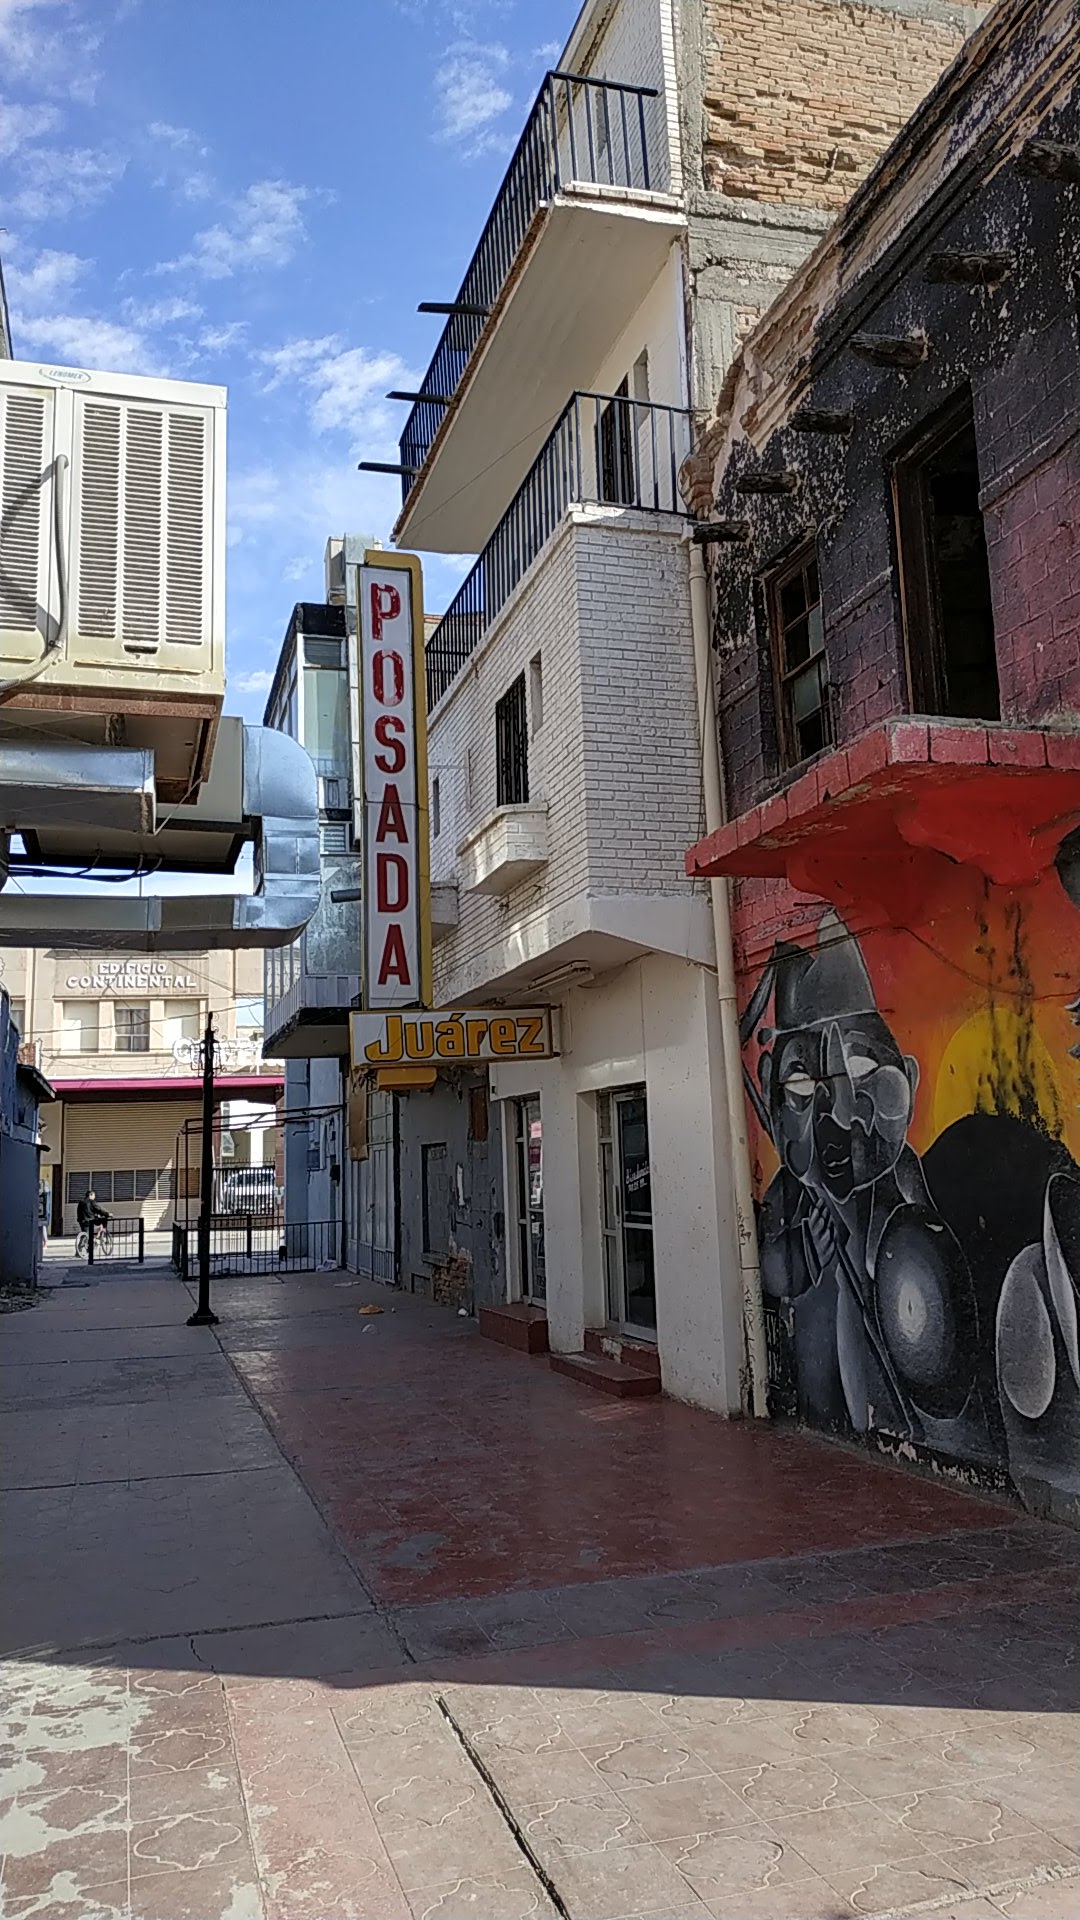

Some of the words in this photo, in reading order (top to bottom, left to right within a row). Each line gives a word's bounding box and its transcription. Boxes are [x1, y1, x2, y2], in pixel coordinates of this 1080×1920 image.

[370, 581, 411, 986] POSADA
[66, 974, 197, 989] CONTINENTAL
[98, 962, 167, 975] EDIFICIO
[364, 1011, 545, 1063] Juárez
